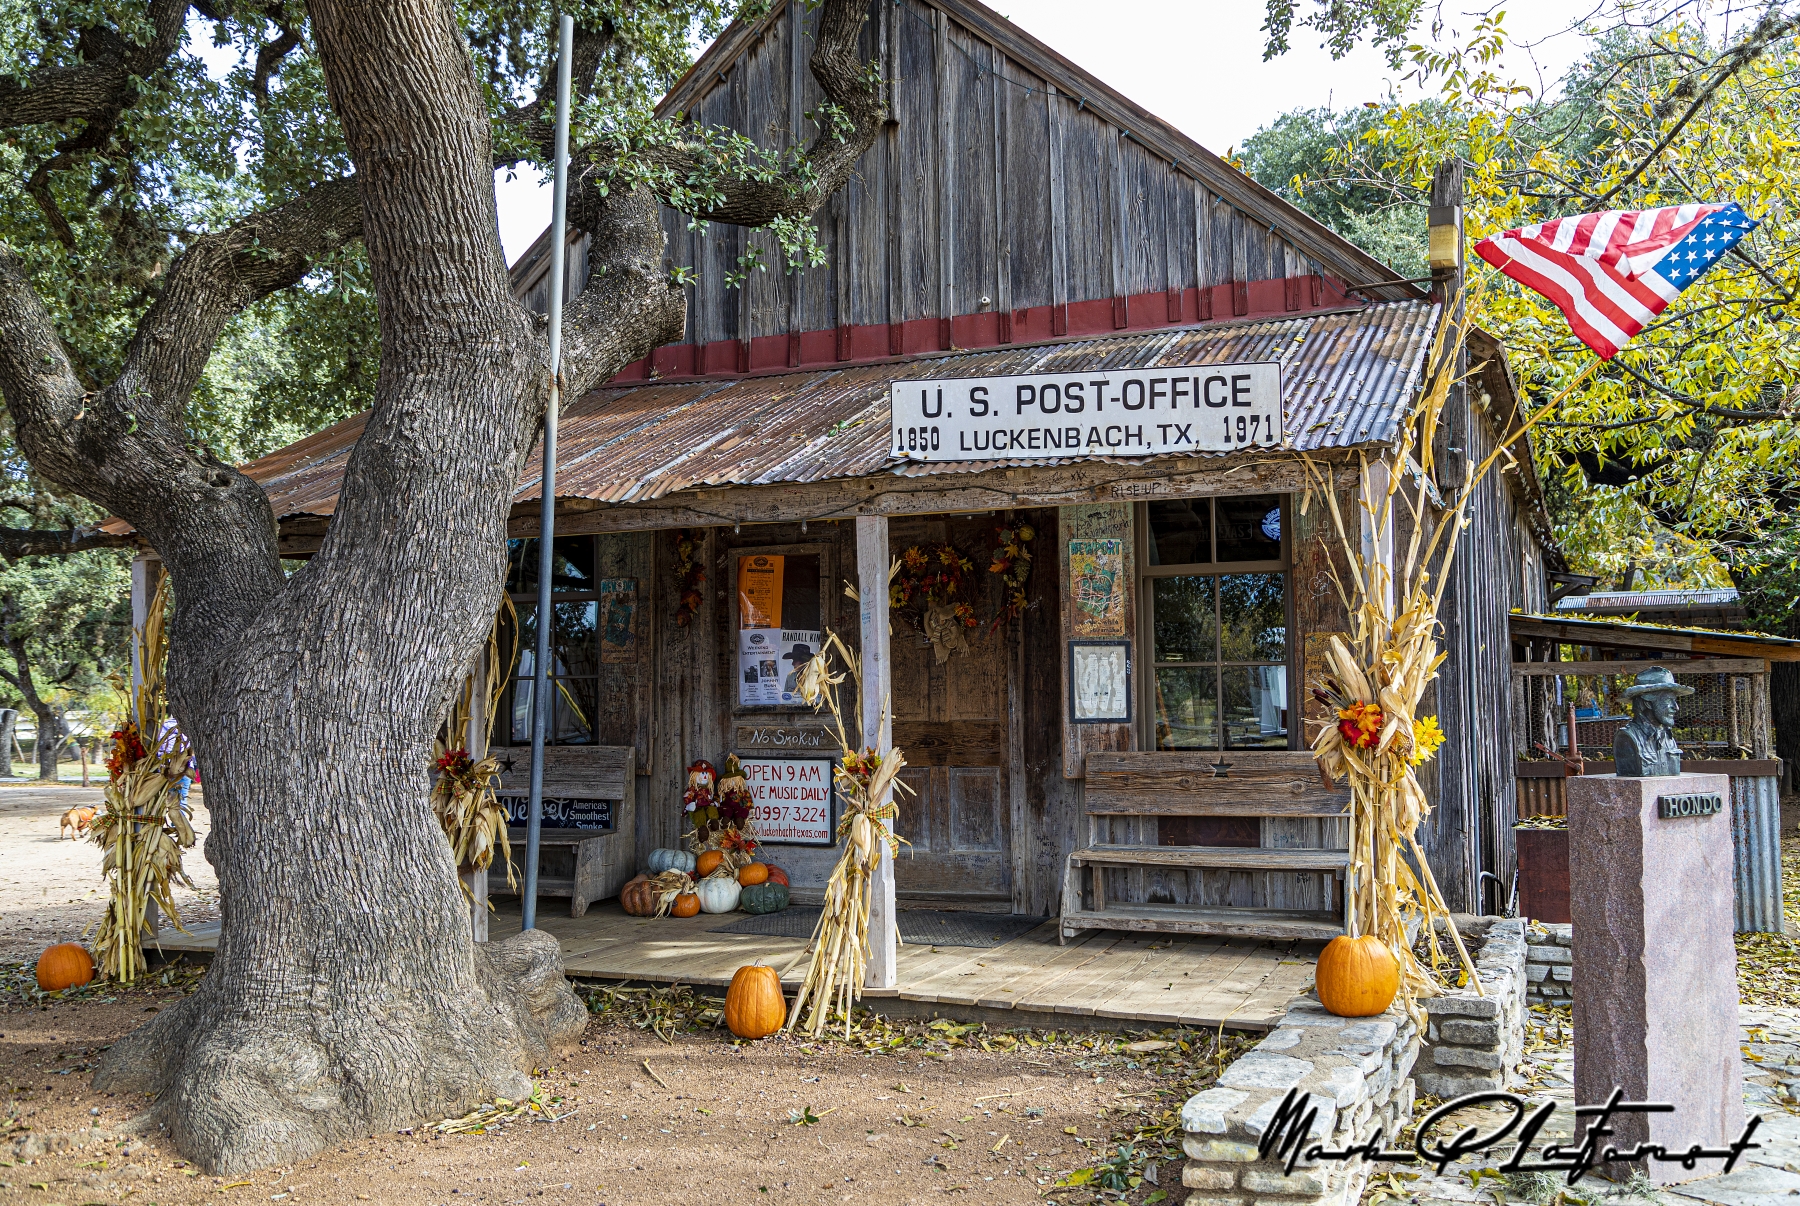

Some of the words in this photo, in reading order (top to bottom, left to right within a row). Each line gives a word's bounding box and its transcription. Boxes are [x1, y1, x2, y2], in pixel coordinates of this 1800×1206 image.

[921, 388, 952, 418] U.
[969, 386, 998, 418] S.
[1016, 374, 1252, 416] POST-OFFICE
[897, 426, 940, 452] 1850
[1223, 414, 1274, 444] 1971
[602, 580, 635, 593] NEWORT
[782, 632, 808, 642] RANDALL
[810, 633, 821, 643] KIN
[751, 729, 770, 744] No
[742, 764, 782, 782] OPEN
[787, 765, 796, 782] 9
[799, 766, 822, 782] AM
[747, 786, 766, 799] IVE
[769, 786, 798, 800] MUSIC
[800, 787, 830, 801] DAILY
[502, 796, 570, 822] Vevet
[572, 800, 608, 810] America's
[1668, 792, 1722, 817] HONDO
[570, 811, 610, 820] Smoothest
[576, 822, 604, 830] Smoke
